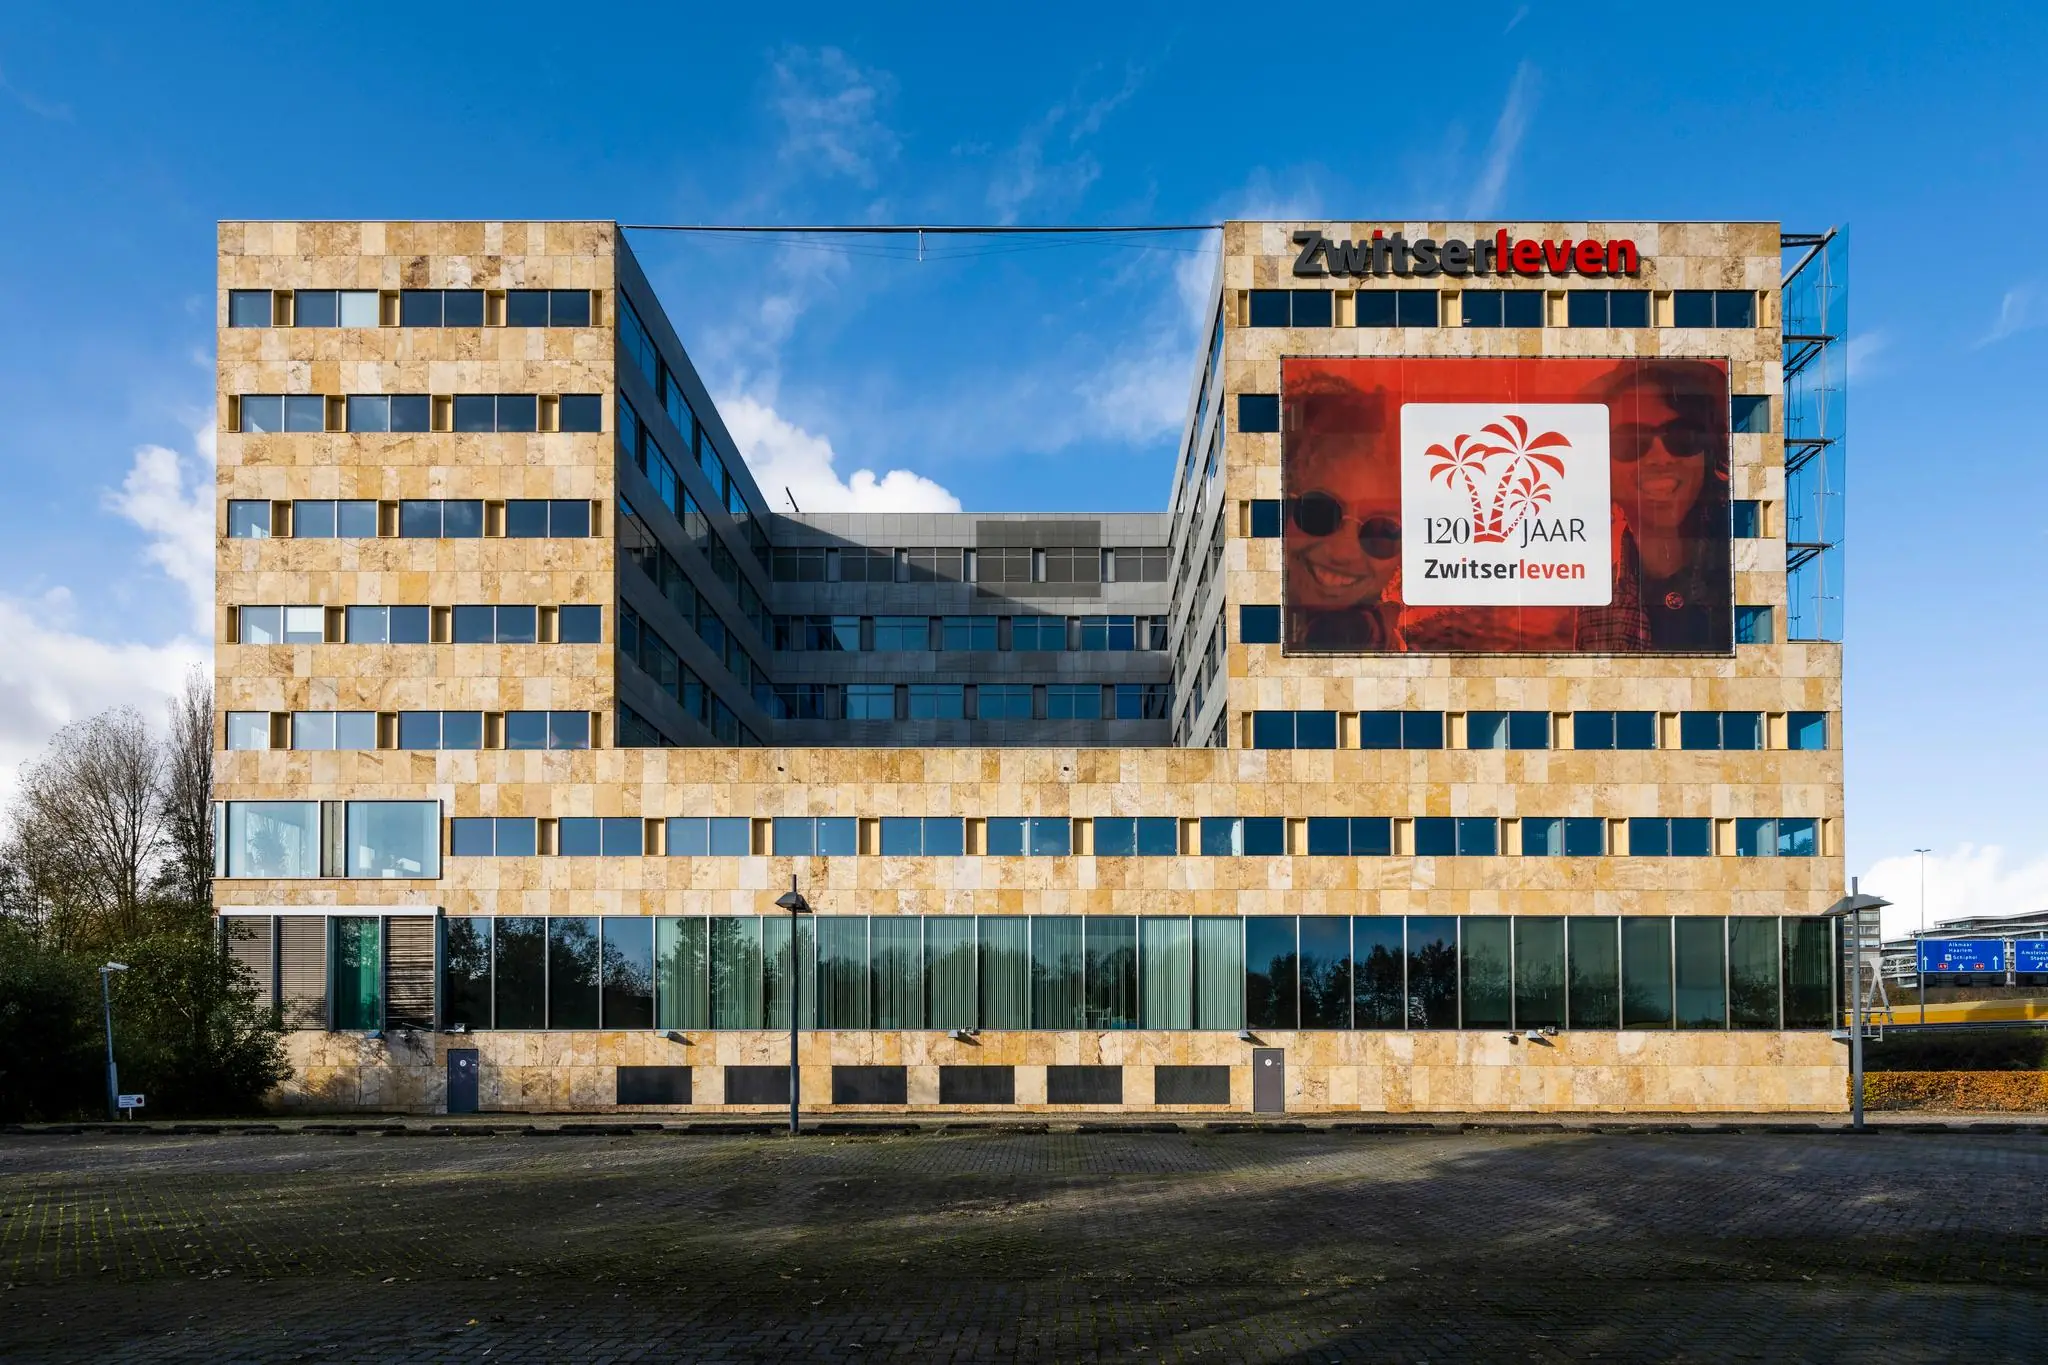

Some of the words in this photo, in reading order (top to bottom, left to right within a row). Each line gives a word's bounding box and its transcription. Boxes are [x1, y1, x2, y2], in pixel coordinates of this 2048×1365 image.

[1292, 229, 1637, 277] Zwitserleven
[1424, 517, 1470, 544] 120
[1520, 518, 1586, 548] JAAR
[1424, 557, 1585, 579] Zwitserleven
